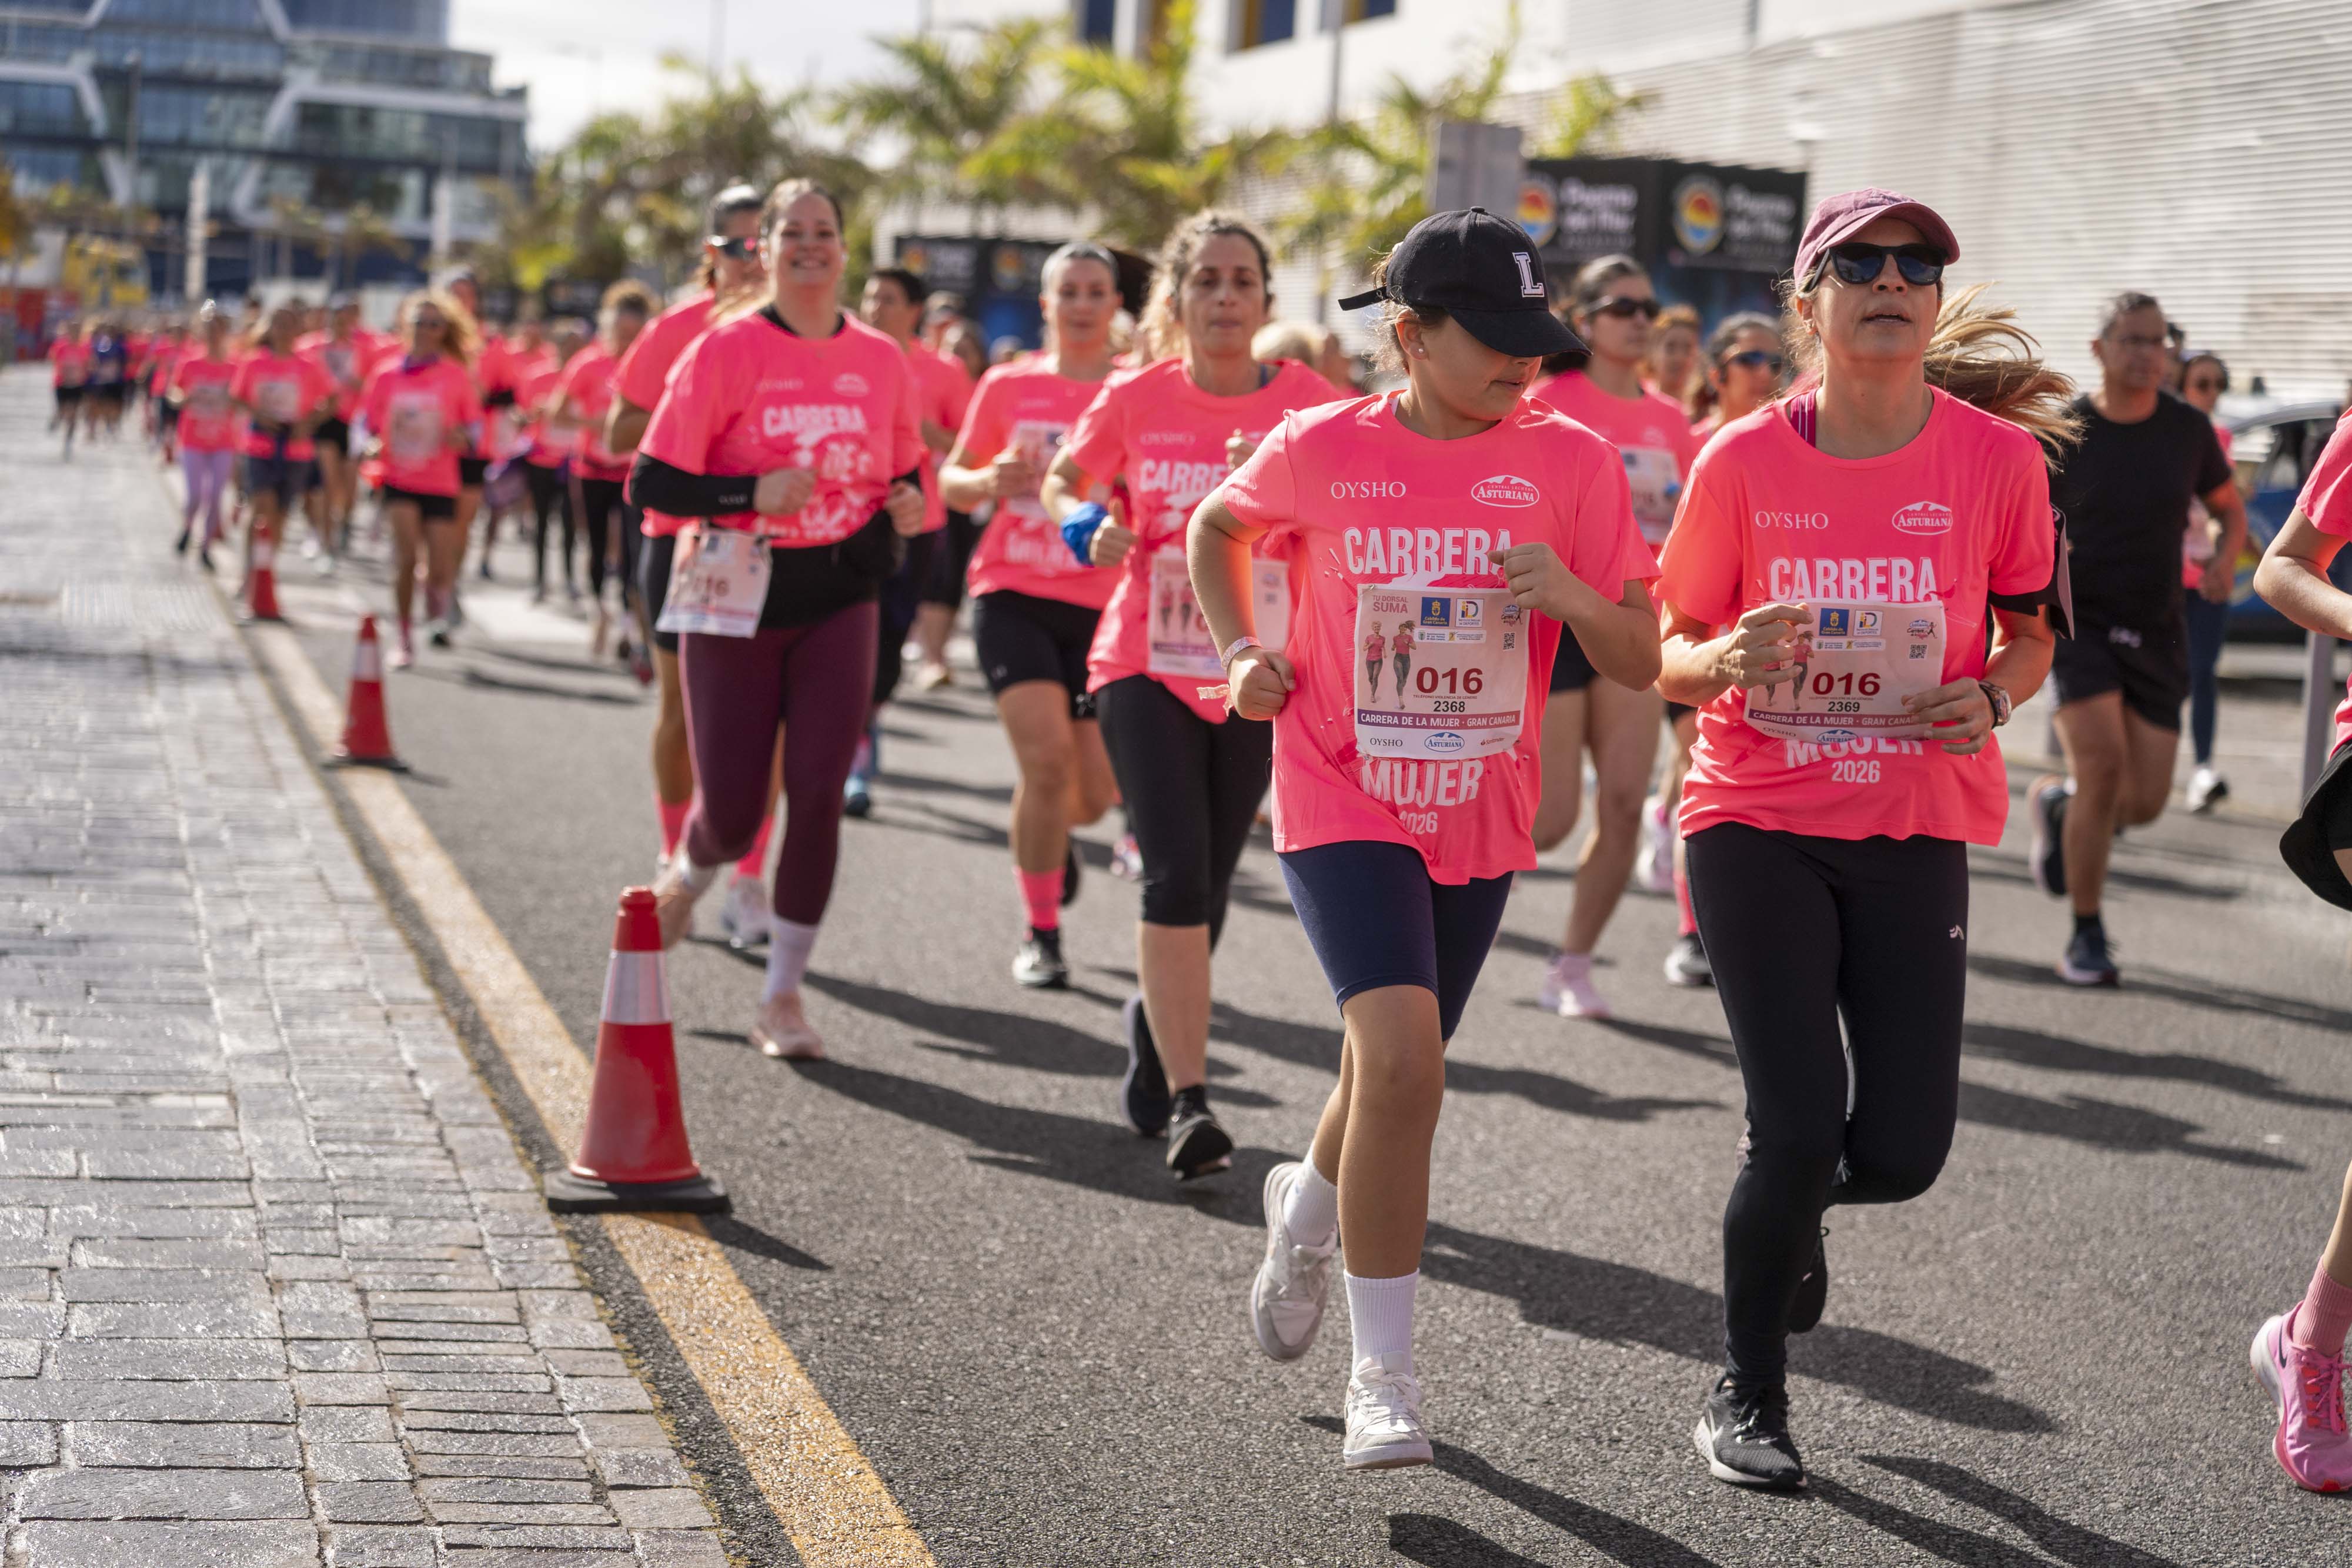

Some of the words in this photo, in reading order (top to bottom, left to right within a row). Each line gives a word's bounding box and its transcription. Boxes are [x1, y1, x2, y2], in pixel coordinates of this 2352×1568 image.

[1512, 252, 1545, 297] L
[1138, 459, 1229, 493] CARRE
[1331, 481, 1406, 499] OYSHO
[1476, 486, 1535, 502] ASTURIANA
[1755, 511, 1829, 529] OYSHO
[1768, 557, 1939, 603] CARRERA
[1373, 601, 1408, 613] SUMA
[1416, 667, 1483, 694] 016
[1812, 672, 1881, 696] 016
[1433, 700, 1466, 713] 2368
[1828, 701, 1860, 713] 2369
[1361, 713, 1399, 725] CARRERA
[1401, 716, 1414, 725] DE
[1415, 717, 1429, 726] LA
[1430, 717, 1460, 727] MUJER
[1467, 717, 1487, 727] GRAN
[1489, 714, 1516, 725] CANARIA
[1753, 712, 1793, 724] CARRERA
[1796, 716, 1808, 724] DE
[1823, 717, 1854, 725] MUJER
[1862, 717, 1886, 726] GRAN
[1887, 716, 1913, 726] CANA
[1762, 727, 1797, 737] OYSHO
[1369, 738, 1404, 747] OYSHO
[1427, 739, 1462, 747] ASTURIANA
[1832, 760, 1880, 783] 2026
[1360, 757, 1485, 809] MUJER
